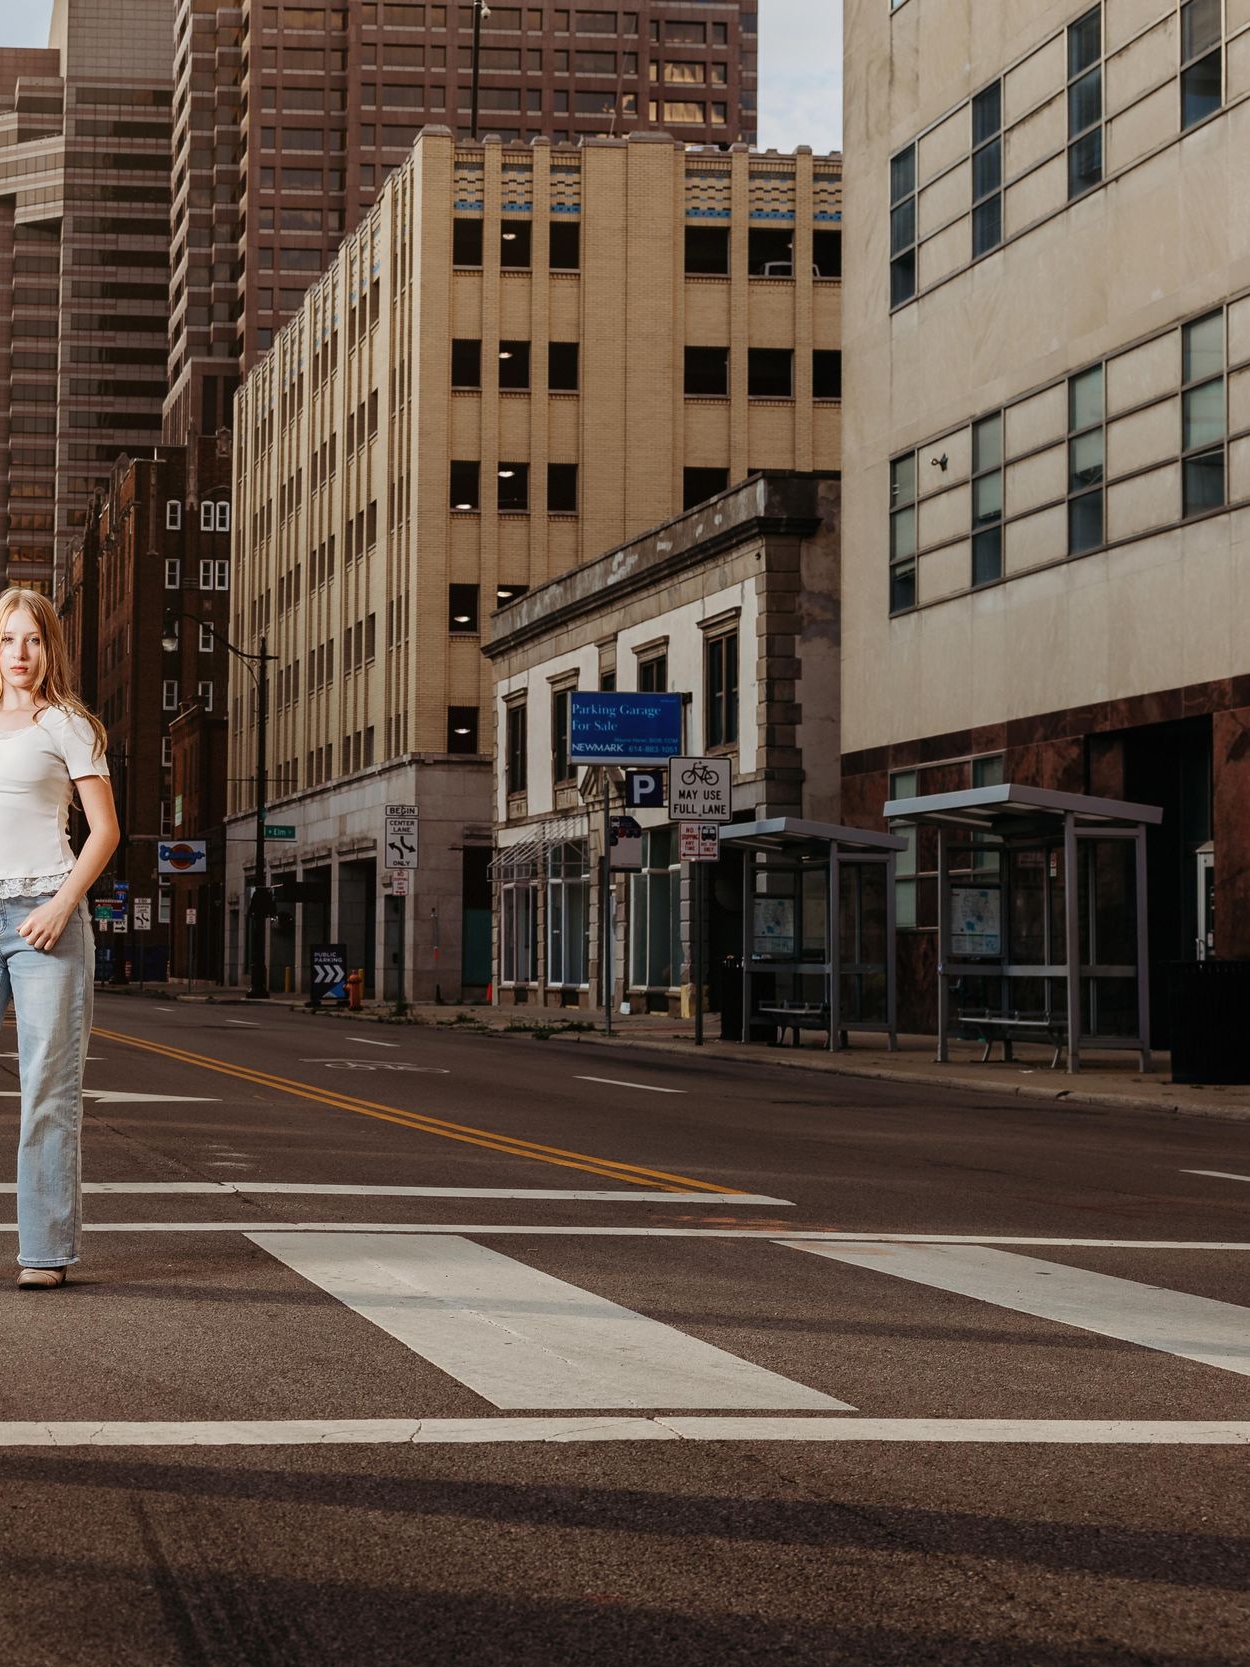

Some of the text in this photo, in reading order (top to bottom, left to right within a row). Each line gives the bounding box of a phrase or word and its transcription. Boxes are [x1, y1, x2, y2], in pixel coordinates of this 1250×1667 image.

[572, 703, 662, 718] Parking Garage
[572, 719, 618, 731] For Sale
[572, 743, 624, 753] NEWMARK
[633, 774, 656, 804] P
[678, 790, 722, 800] MAY USE
[389, 807, 415, 815] BEGIN
[673, 803, 727, 815] FULL LANE
[273, 828, 286, 836] Elm
